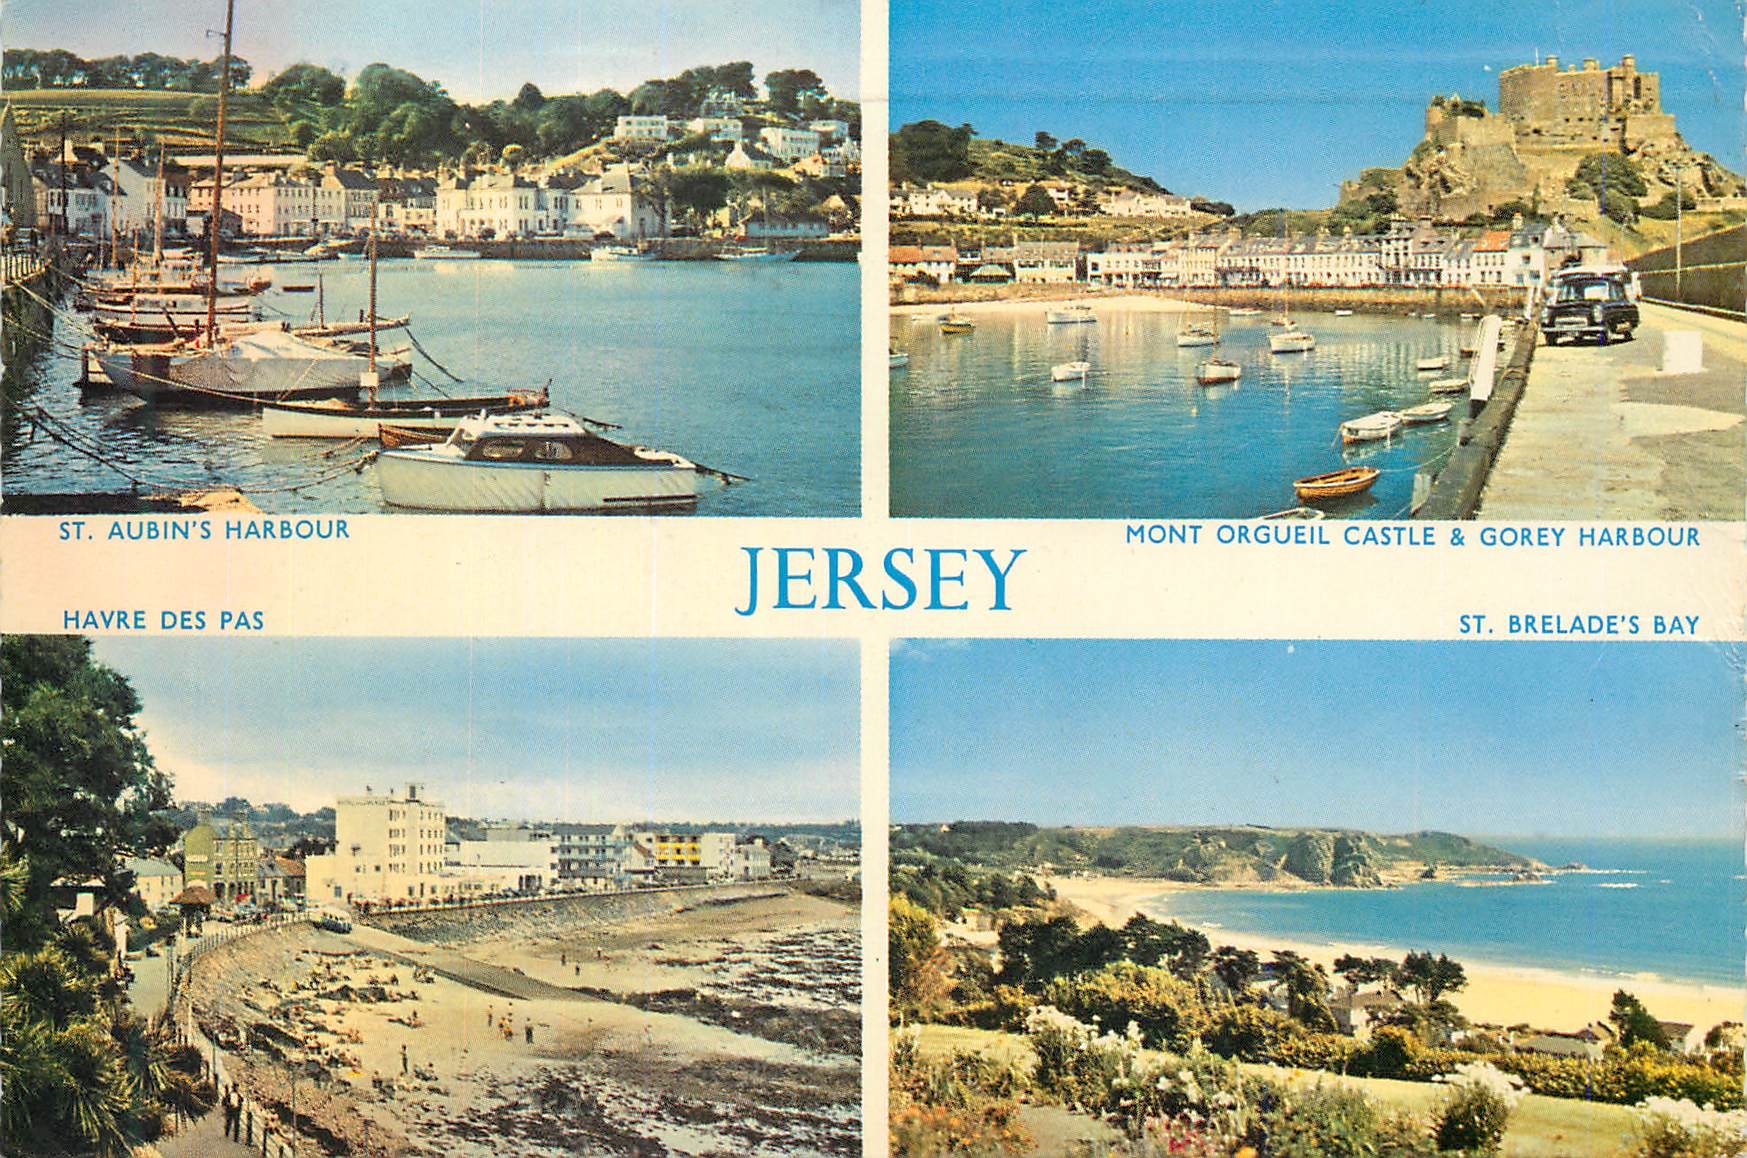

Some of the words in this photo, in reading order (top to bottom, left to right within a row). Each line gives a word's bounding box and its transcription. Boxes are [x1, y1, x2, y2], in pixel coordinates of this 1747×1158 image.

[60, 521, 93, 541] ST.
[109, 520, 211, 540] AUBIN'S
[226, 519, 350, 540] HARBOUR
[1127, 524, 1203, 544] MONT
[1217, 525, 1330, 545] ORGUEIL
[1344, 526, 1436, 546] CASTLE
[1451, 527, 1465, 546] &
[1481, 527, 1565, 546] GOREY
[1580, 527, 1700, 546] HARBOUR
[735, 547, 1027, 617] JERSEY
[64, 610, 146, 630] HAVRE
[162, 610, 206, 630] DES
[220, 611, 264, 630] PAS
[1460, 614, 1493, 634] ST.
[1509, 614, 1640, 635] BRELADE'S
[1654, 615, 1699, 635] BAY
